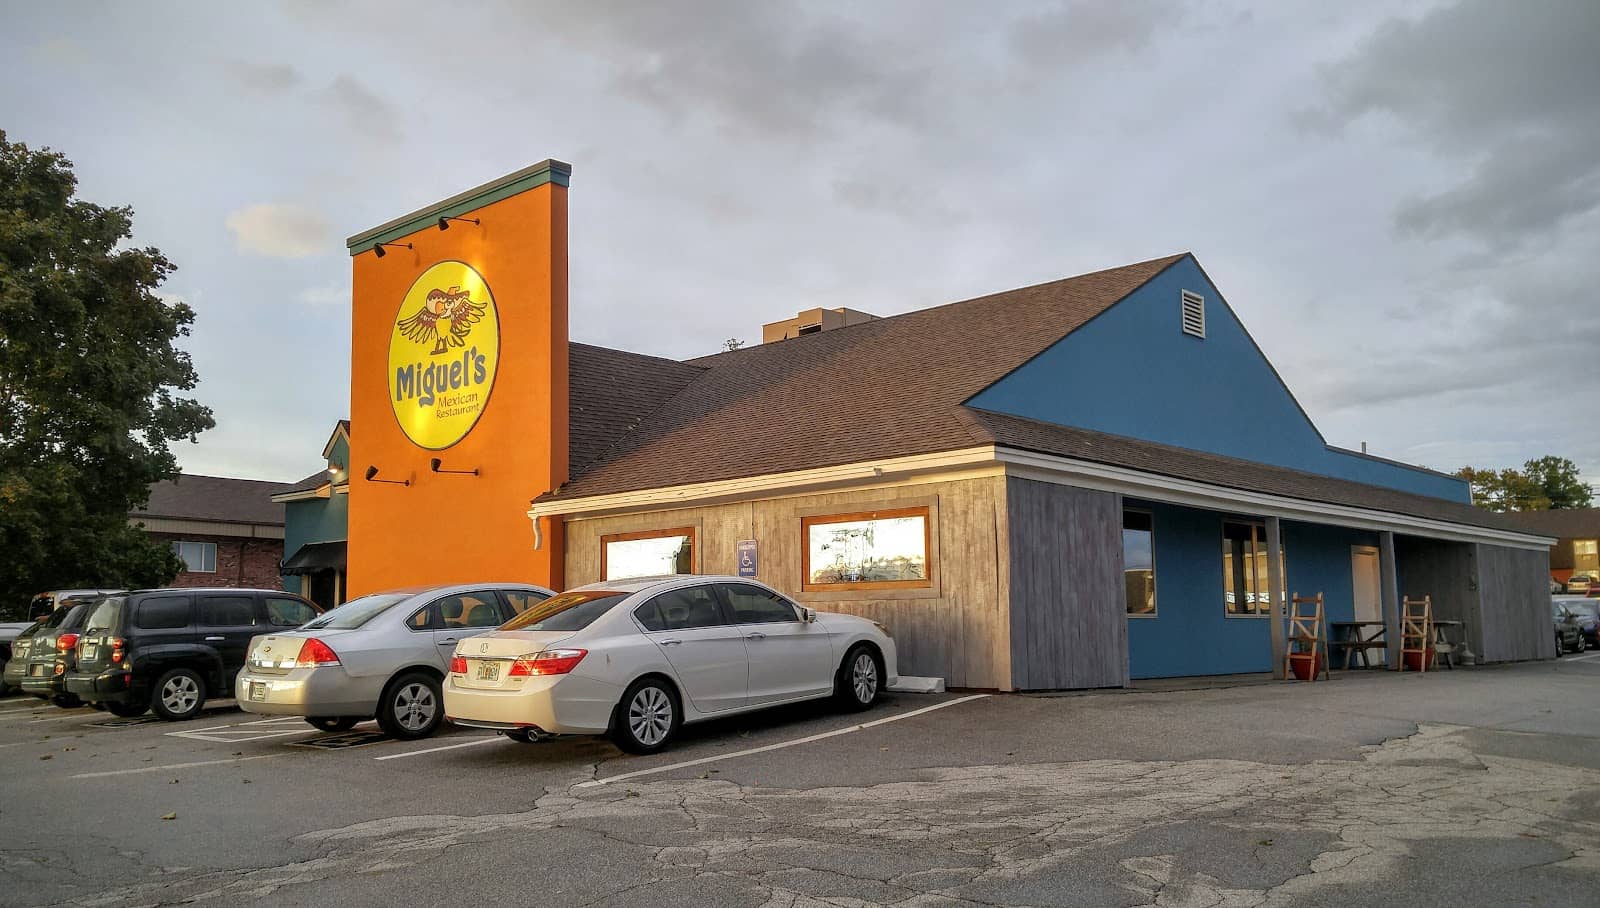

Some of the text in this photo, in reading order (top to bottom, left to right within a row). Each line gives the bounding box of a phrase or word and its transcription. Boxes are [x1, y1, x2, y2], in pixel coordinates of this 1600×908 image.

[396, 346, 487, 408] Miguel's
[438, 393, 478, 407] Mexican
[436, 403, 480, 419] Restaurant
